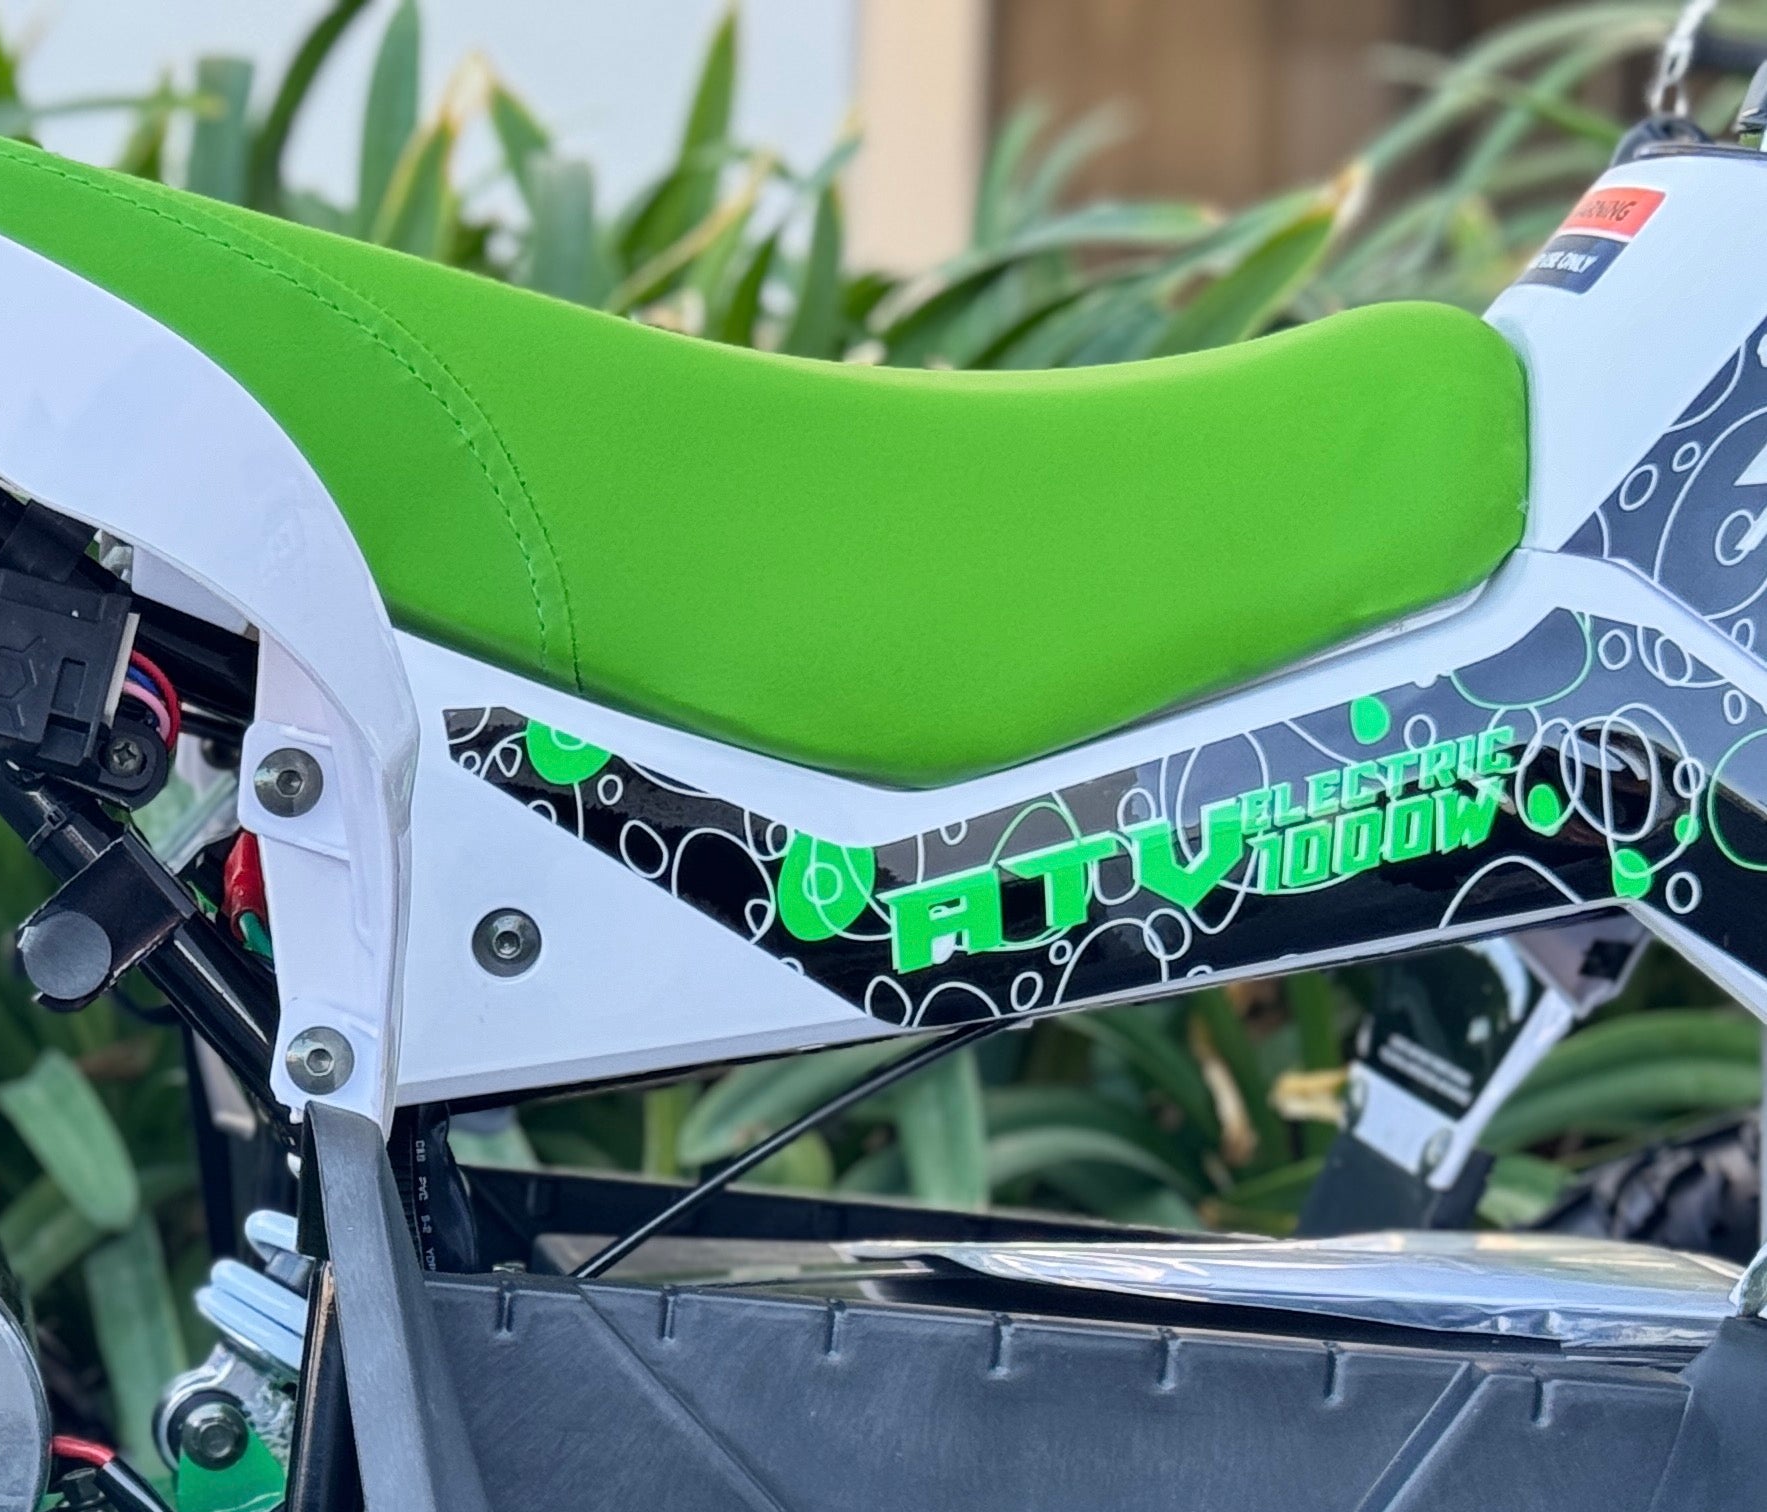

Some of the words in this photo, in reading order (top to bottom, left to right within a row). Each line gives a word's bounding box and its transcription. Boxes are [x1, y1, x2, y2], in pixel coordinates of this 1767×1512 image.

[1237, 725, 1516, 835] ELECTRIC
[1245, 777, 1505, 896] 1000W
[875, 797, 1243, 974] ATV
